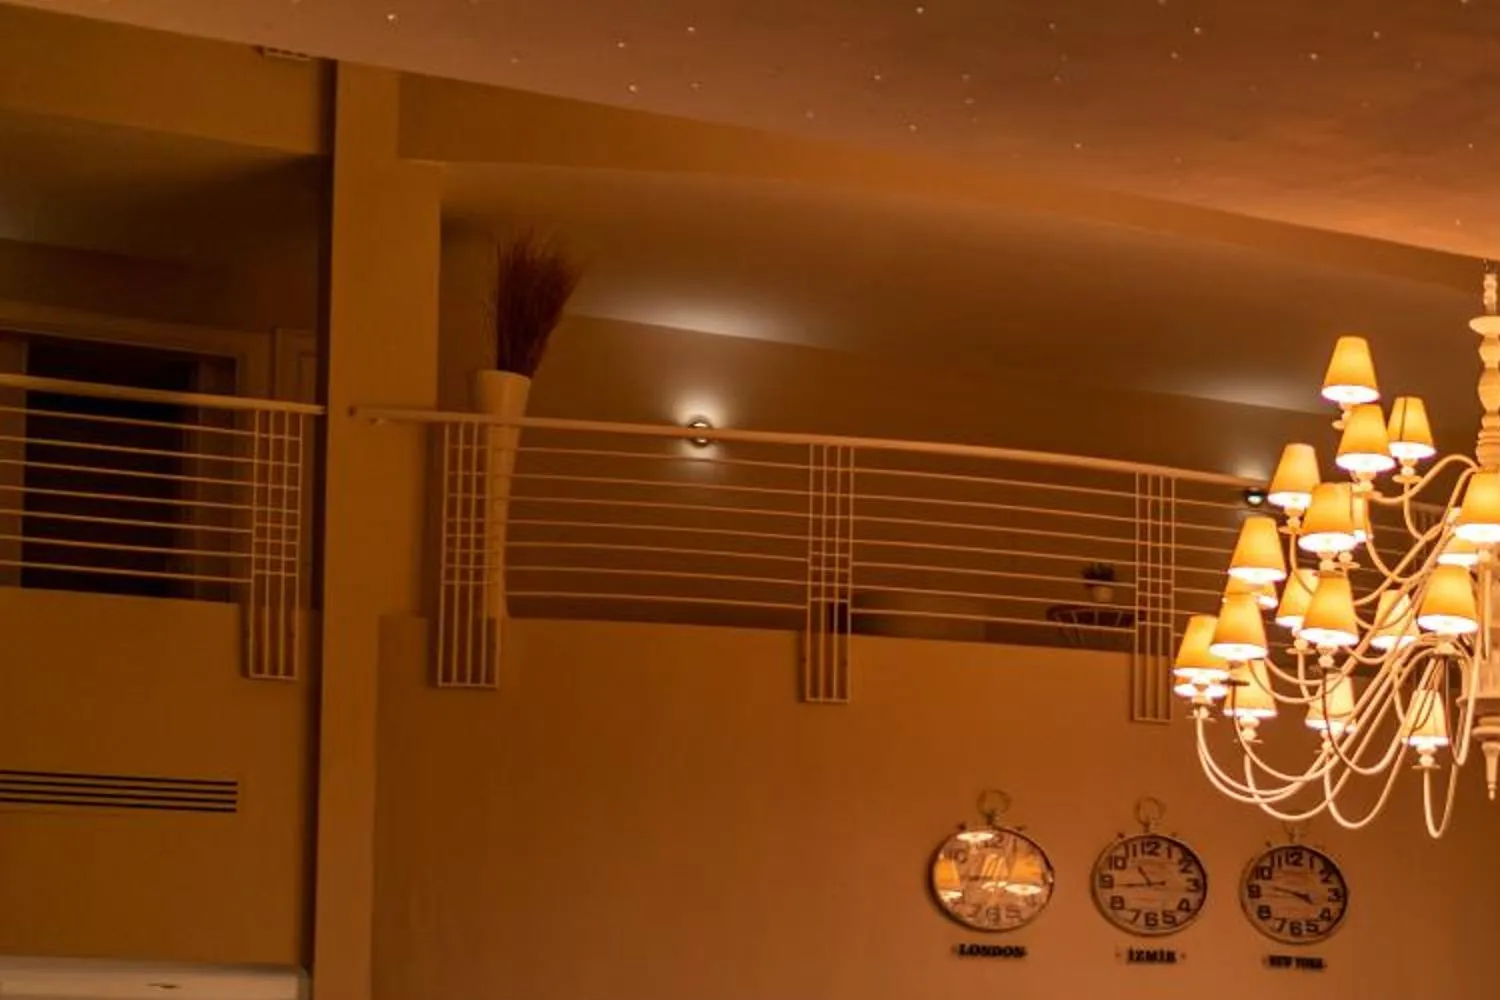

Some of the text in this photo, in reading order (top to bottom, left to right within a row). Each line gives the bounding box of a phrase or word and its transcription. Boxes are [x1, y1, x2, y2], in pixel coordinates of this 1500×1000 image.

[1125, 843, 1138, 858] 11
[1141, 840, 1161, 856] 12
[1167, 845, 1173, 859] 1
[1108, 855, 1127, 870] 10
[1178, 856, 1193, 874] 2
[1271, 854, 1282, 869] 11
[1285, 851, 1303, 866] 12
[1254, 865, 1272, 879] 10
[1319, 867, 1333, 884] 2
[1099, 874, 1114, 889] 9
[1185, 878, 1200, 892] 3
[1247, 884, 1262, 899] 9
[1327, 888, 1341, 902] 3
[1110, 895, 1125, 911] 8
[1177, 898, 1191, 912] 4
[1127, 908, 1142, 924] 7
[1144, 911, 1159, 927] 6
[1162, 909, 1177, 925] 5
[1256, 905, 1271, 920] 8
[1319, 907, 1332, 921] 4
[1273, 918, 1287, 932] 7
[1289, 921, 1303, 936] 6
[1305, 919, 1319, 935] 5
[958, 943, 1026, 959] LONDON
